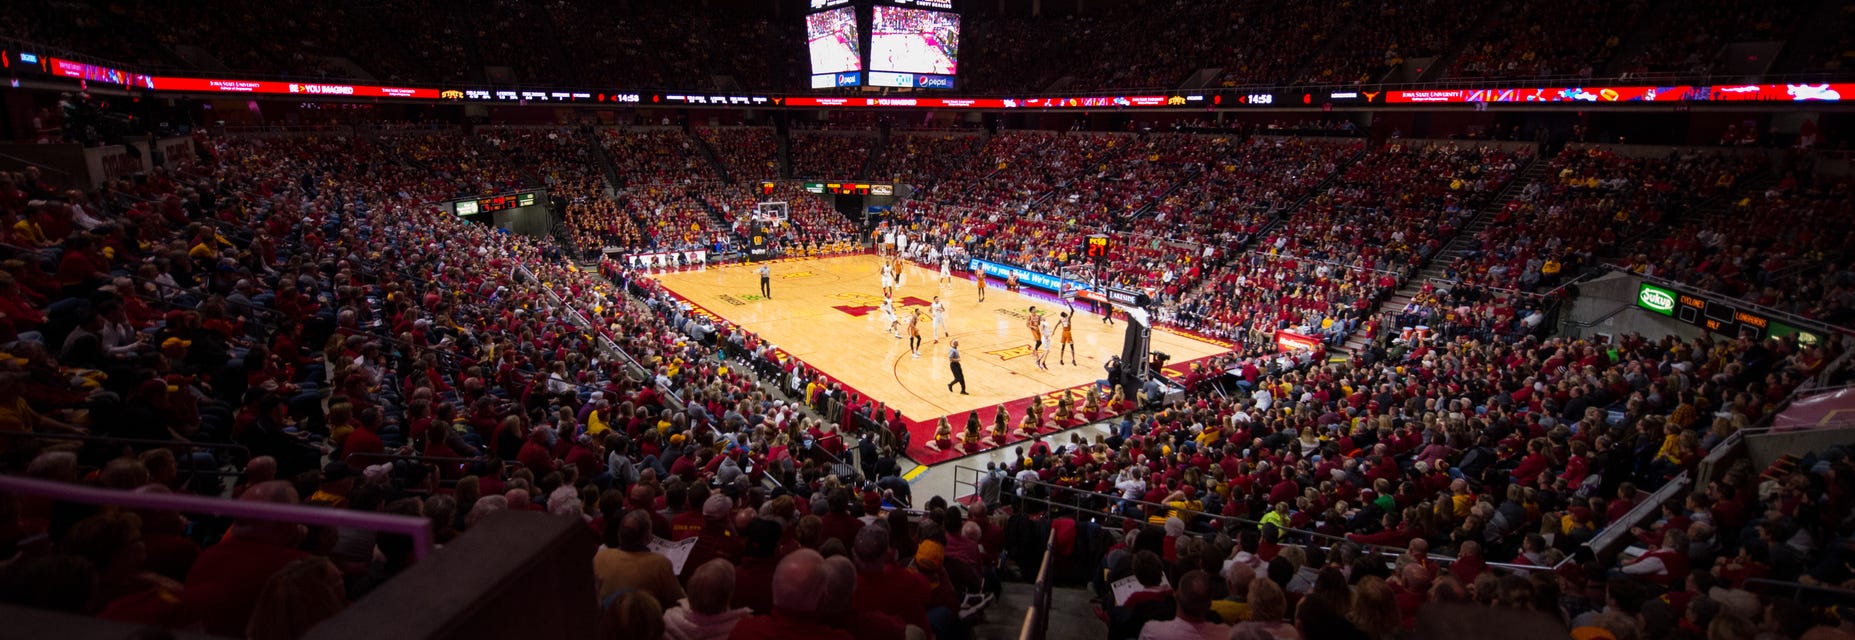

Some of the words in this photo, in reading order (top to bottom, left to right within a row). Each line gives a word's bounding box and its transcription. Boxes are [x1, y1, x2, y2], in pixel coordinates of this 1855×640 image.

[289, 84, 299, 93] BE
[305, 84, 321, 93] YOU
[321, 85, 354, 94] IMAGINED
[928, 78, 947, 87] pepsi
[617, 94, 640, 102] 14:58
[1247, 94, 1273, 104] 14:58
[1088, 244, 1105, 257] 27
[1031, 272, 1050, 285] We're
[1109, 290, 1137, 304] LAKESIDE
[1643, 288, 1672, 309] Sukup
[1680, 295, 1705, 310] CYCLONES
[1735, 312, 1767, 328] LONGHORNS
